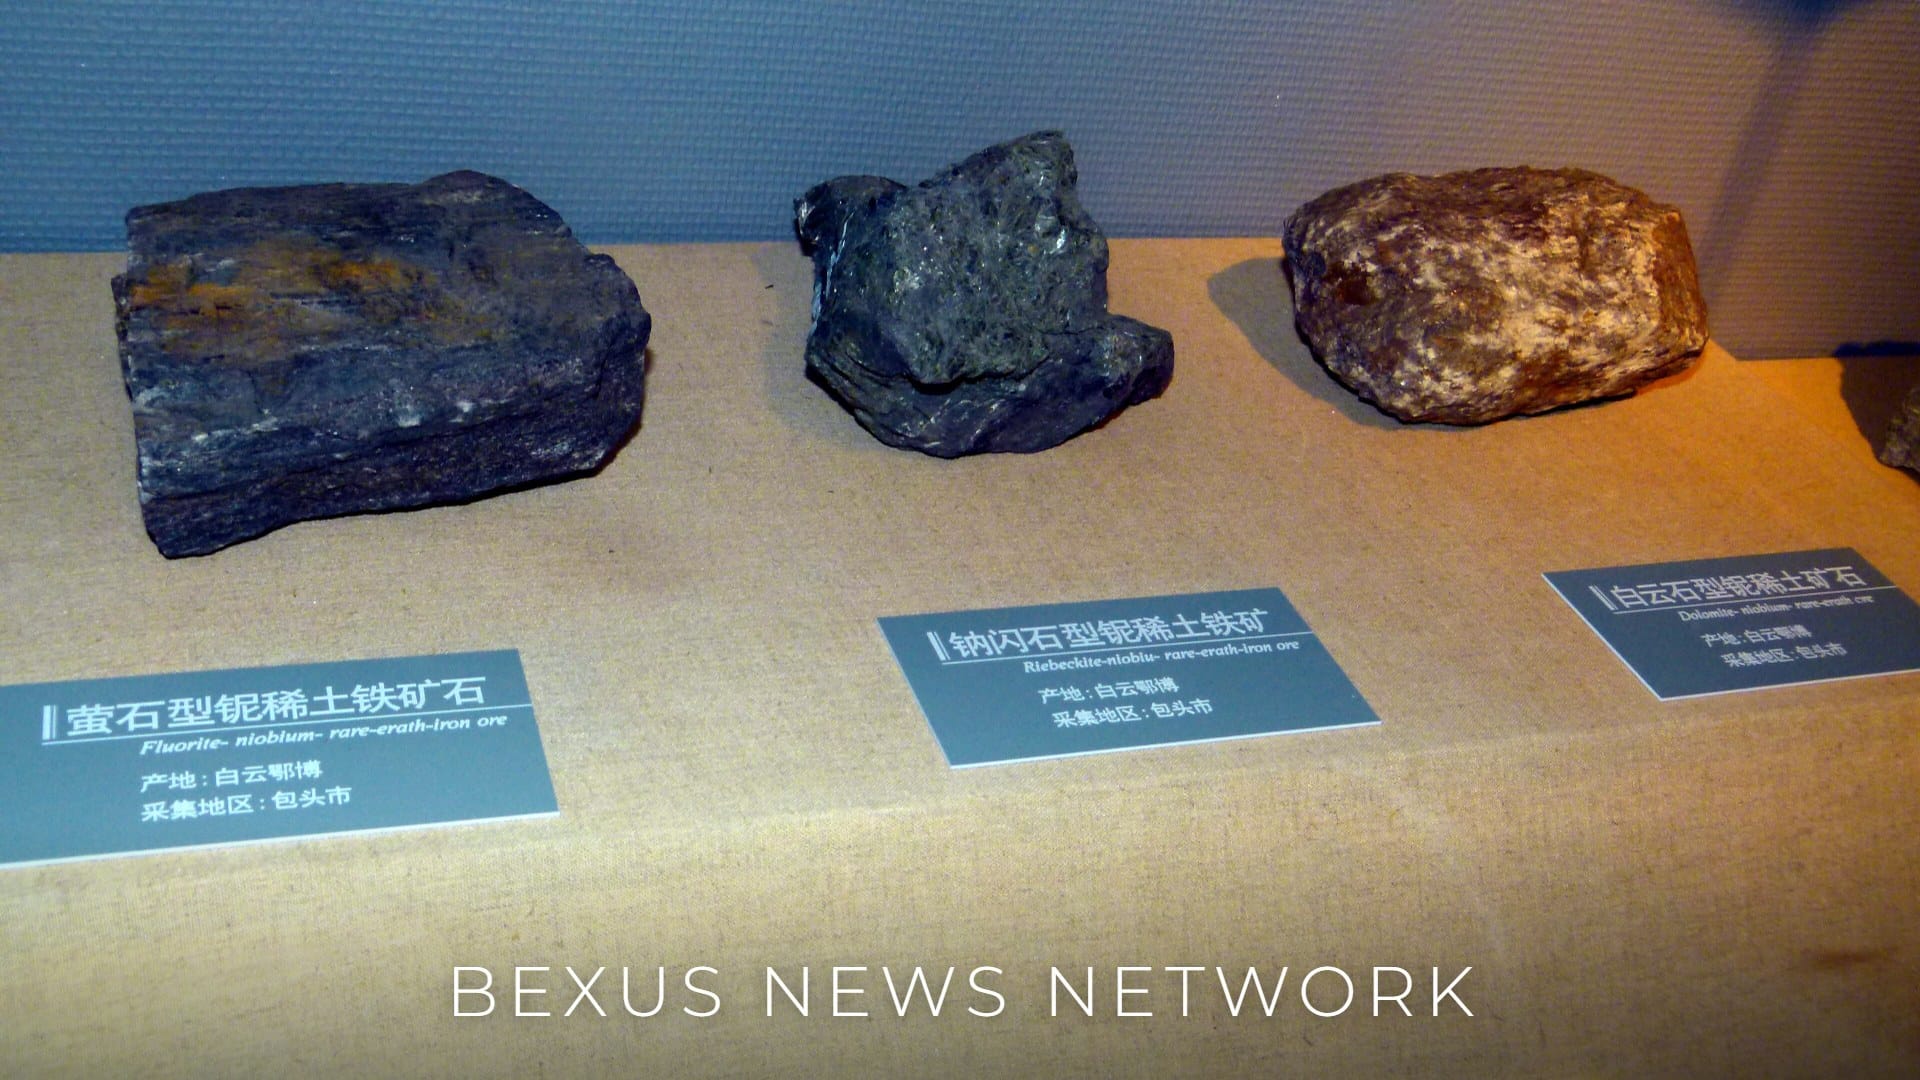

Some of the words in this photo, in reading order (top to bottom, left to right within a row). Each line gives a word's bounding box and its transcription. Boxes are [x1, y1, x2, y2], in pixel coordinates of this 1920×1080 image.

[1611, 566, 1867, 608] 白云石型铌稀土矿石
[949, 608, 1269, 657] 钠闪石型铌稀土铁矿
[1165, 642, 1272, 661] rare-erath-iron
[1277, 640, 1300, 650] ore
[67, 676, 487, 736] 萤石型铌稀土铁矿石
[140, 739, 229, 755] Fluorite-
[236, 730, 323, 747] niobium-
[329, 716, 470, 740] rare-erath-iron
[477, 714, 508, 728] ore
